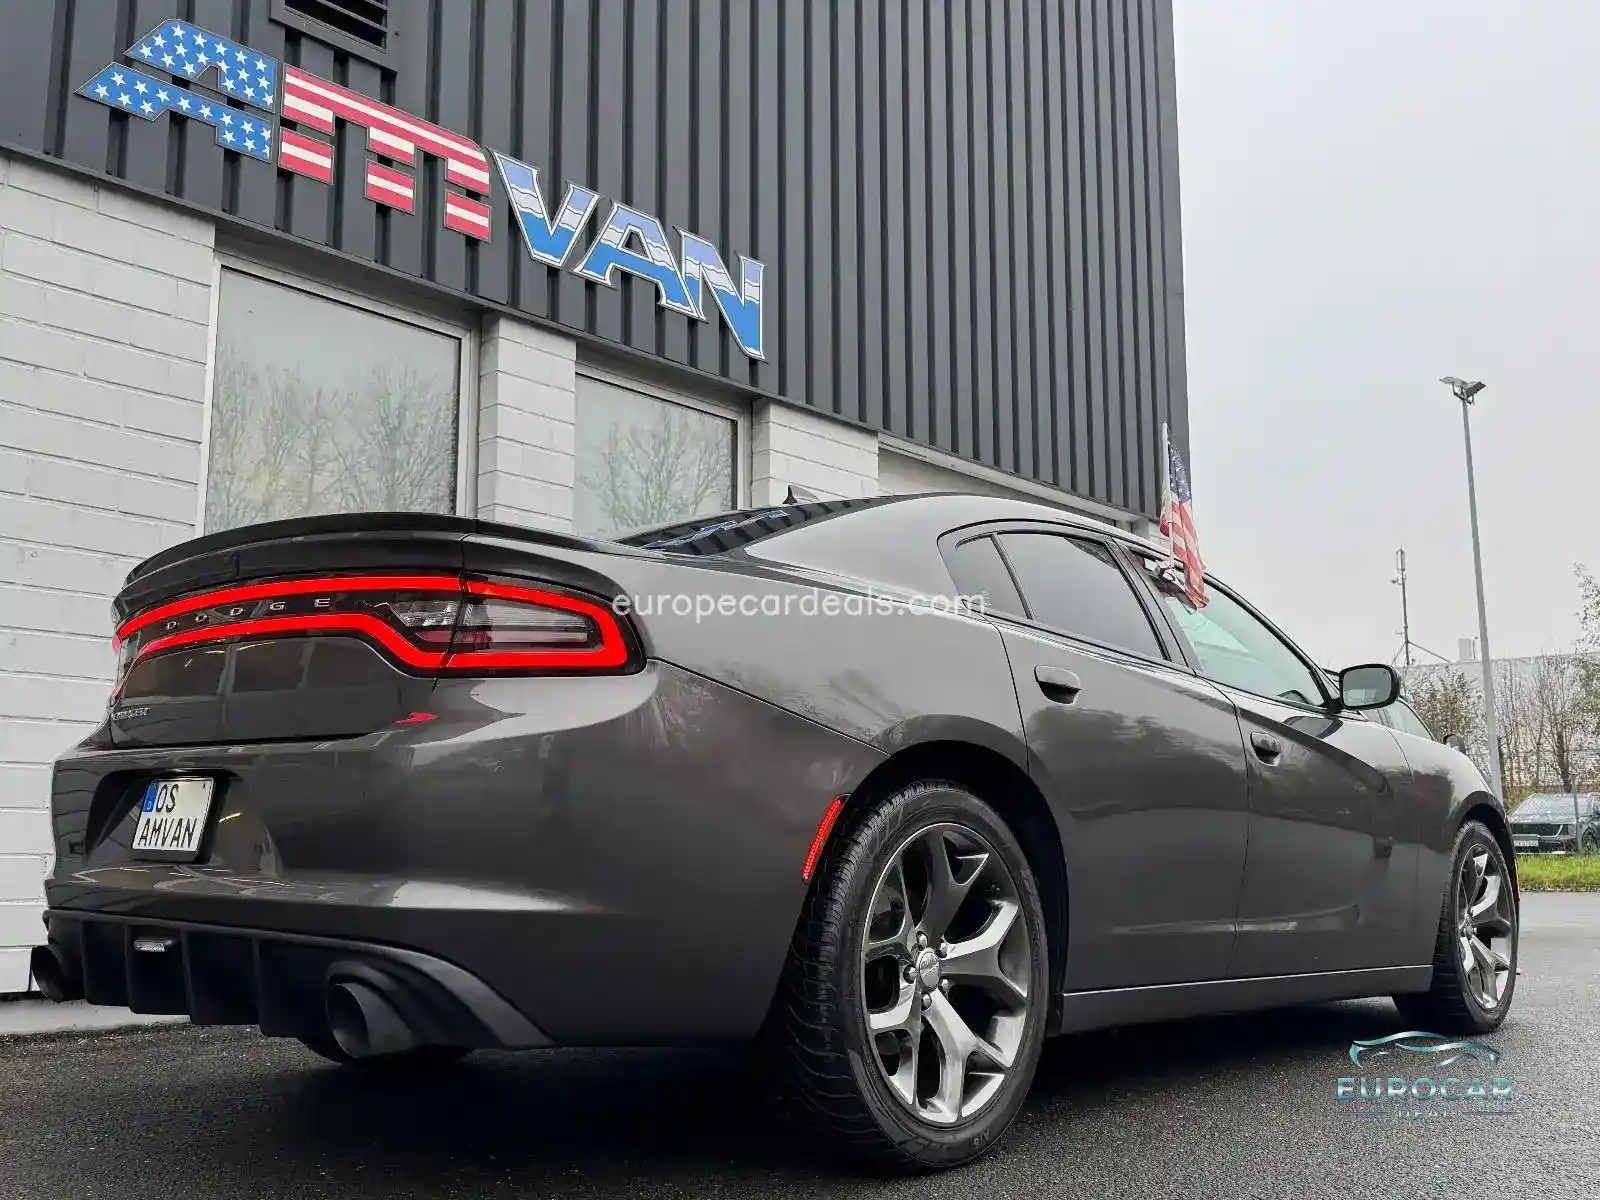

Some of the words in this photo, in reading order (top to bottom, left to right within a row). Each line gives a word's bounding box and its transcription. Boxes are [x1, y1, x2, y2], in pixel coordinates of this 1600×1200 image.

[165, 598, 331, 630] DODGE
[156, 783, 180, 813] OS
[138, 817, 198, 848] AMVAN
